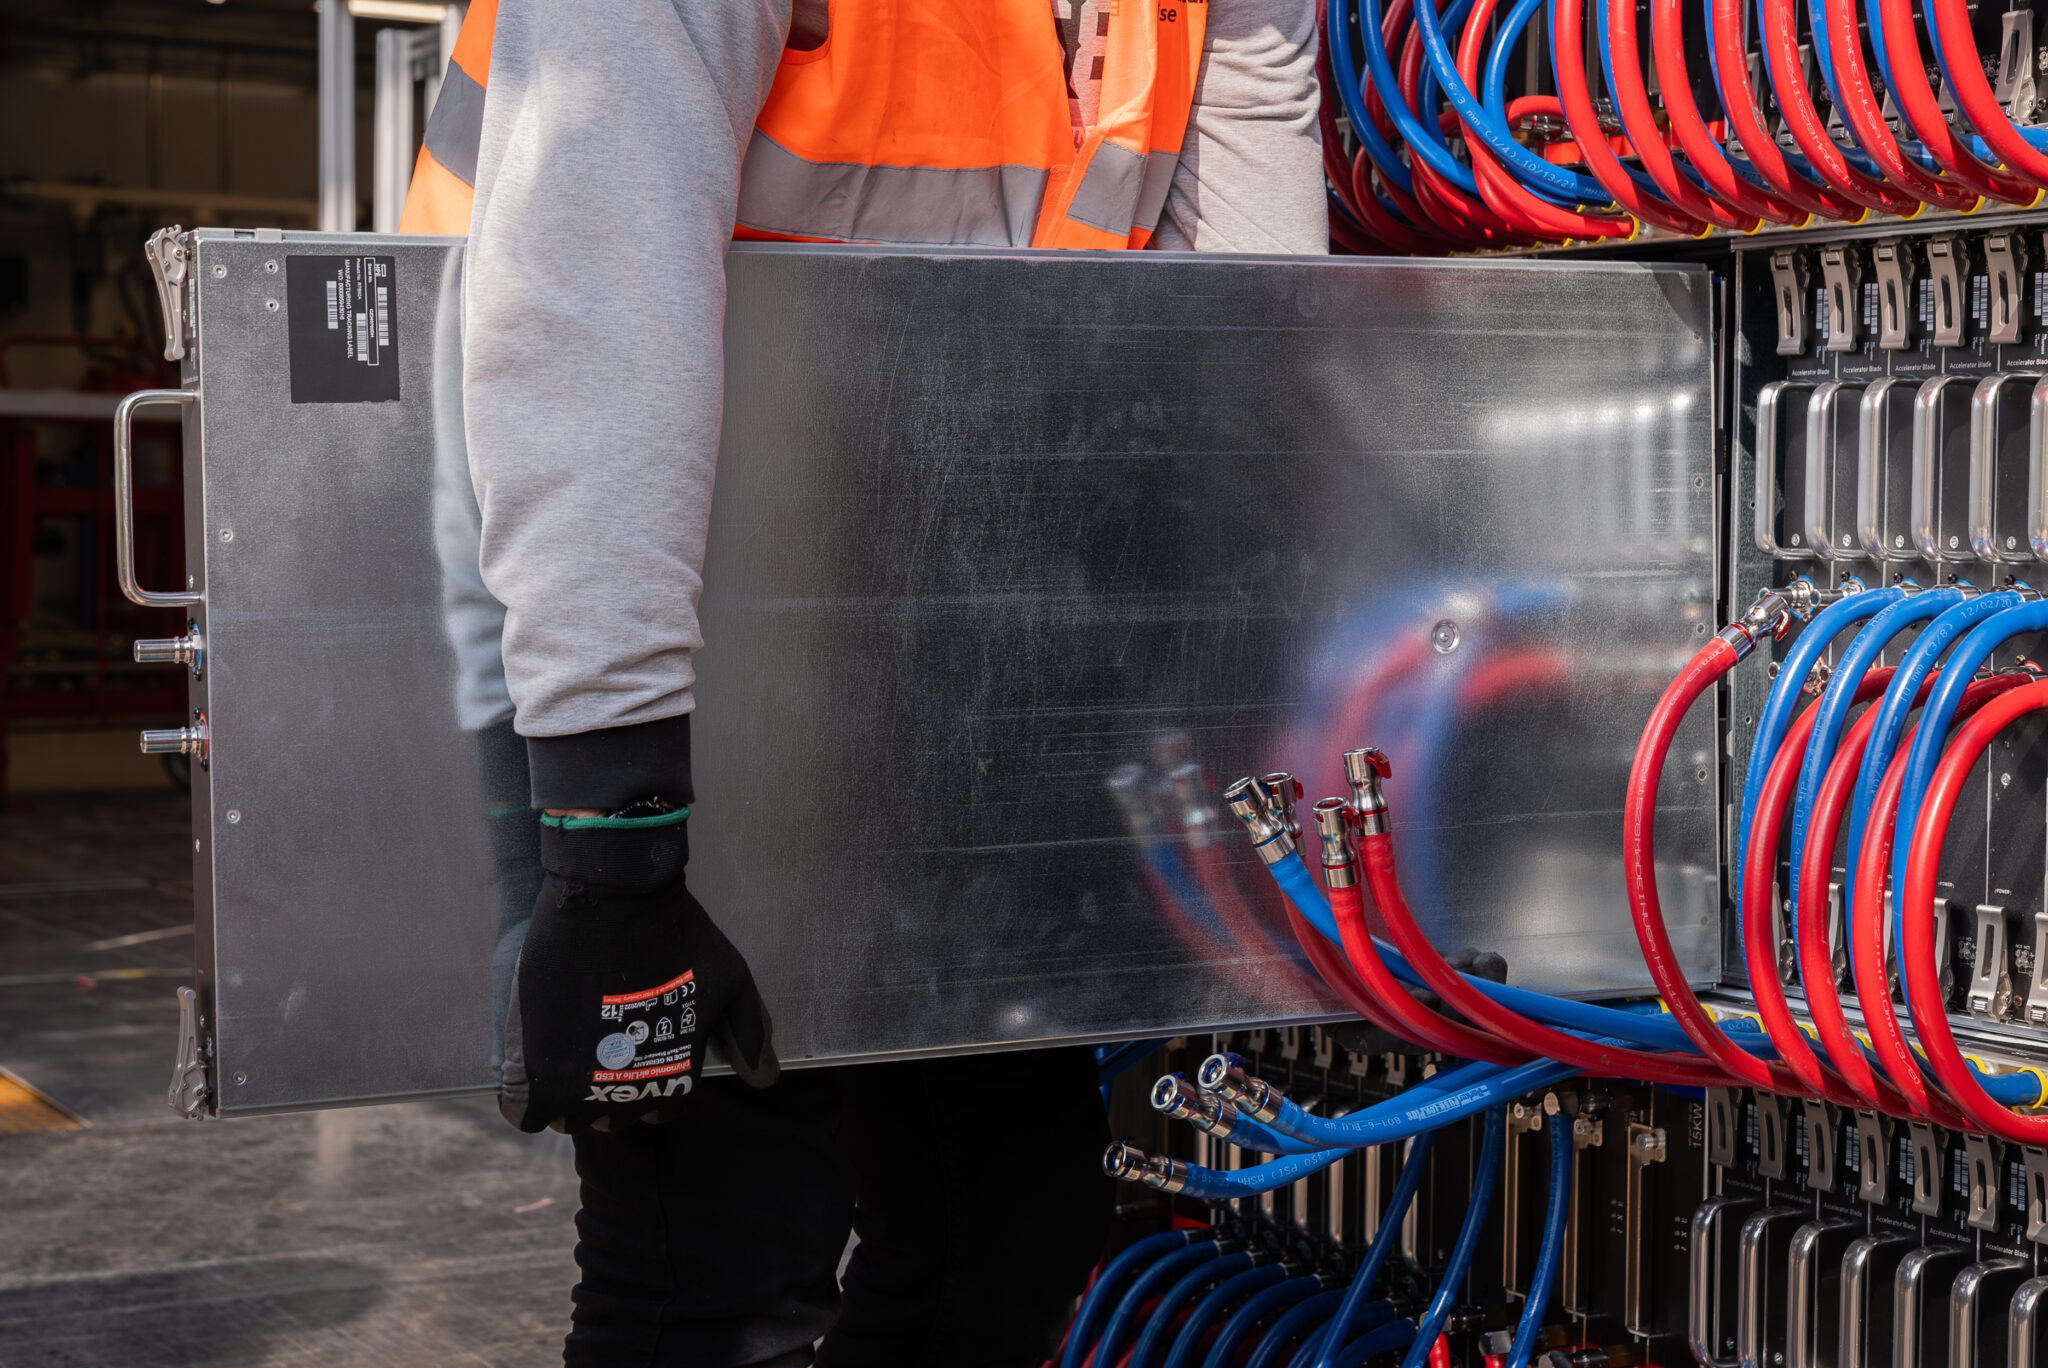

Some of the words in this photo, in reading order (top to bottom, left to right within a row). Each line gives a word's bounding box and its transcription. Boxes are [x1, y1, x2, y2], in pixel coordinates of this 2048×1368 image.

[1464, 107, 1483, 127] mm
[344, 259, 352, 309] MANUFACTURING
[1895, 364, 1922, 372] Accelerator
[1922, 363, 1936, 371] Blade
[1949, 361, 1977, 369] Accelerator
[1977, 360, 1992, 368] Blade
[2006, 359, 2035, 367] Accelerator
[2036, 358, 2048, 366] Blad
[1792, 368, 1817, 377] Accelerator
[1817, 367, 1830, 376] Blade
[1843, 366, 1868, 374] Accelerator
[1869, 364, 1883, 373] Blade
[601, 1004, 618, 1017] 12
[674, 1051, 691, 1061] MADE
[632, 1057, 665, 1068] GERMANY
[650, 1060, 690, 1075] phynomic
[594, 1072, 615, 1081] ESD
[623, 1069, 650, 1079] airLite
[584, 1075, 693, 1103] uvex
[1692, 1103, 1703, 1149] 15KW
[1875, 1215, 1903, 1227] Accelerator
[1903, 1221, 1917, 1232] Blade
[1929, 1227, 1957, 1239] Accelerator
[1957, 1233, 1972, 1244] Blade
[1985, 1242, 2014, 1255] Accelerator
[2014, 1249, 2030, 1259] Blade
